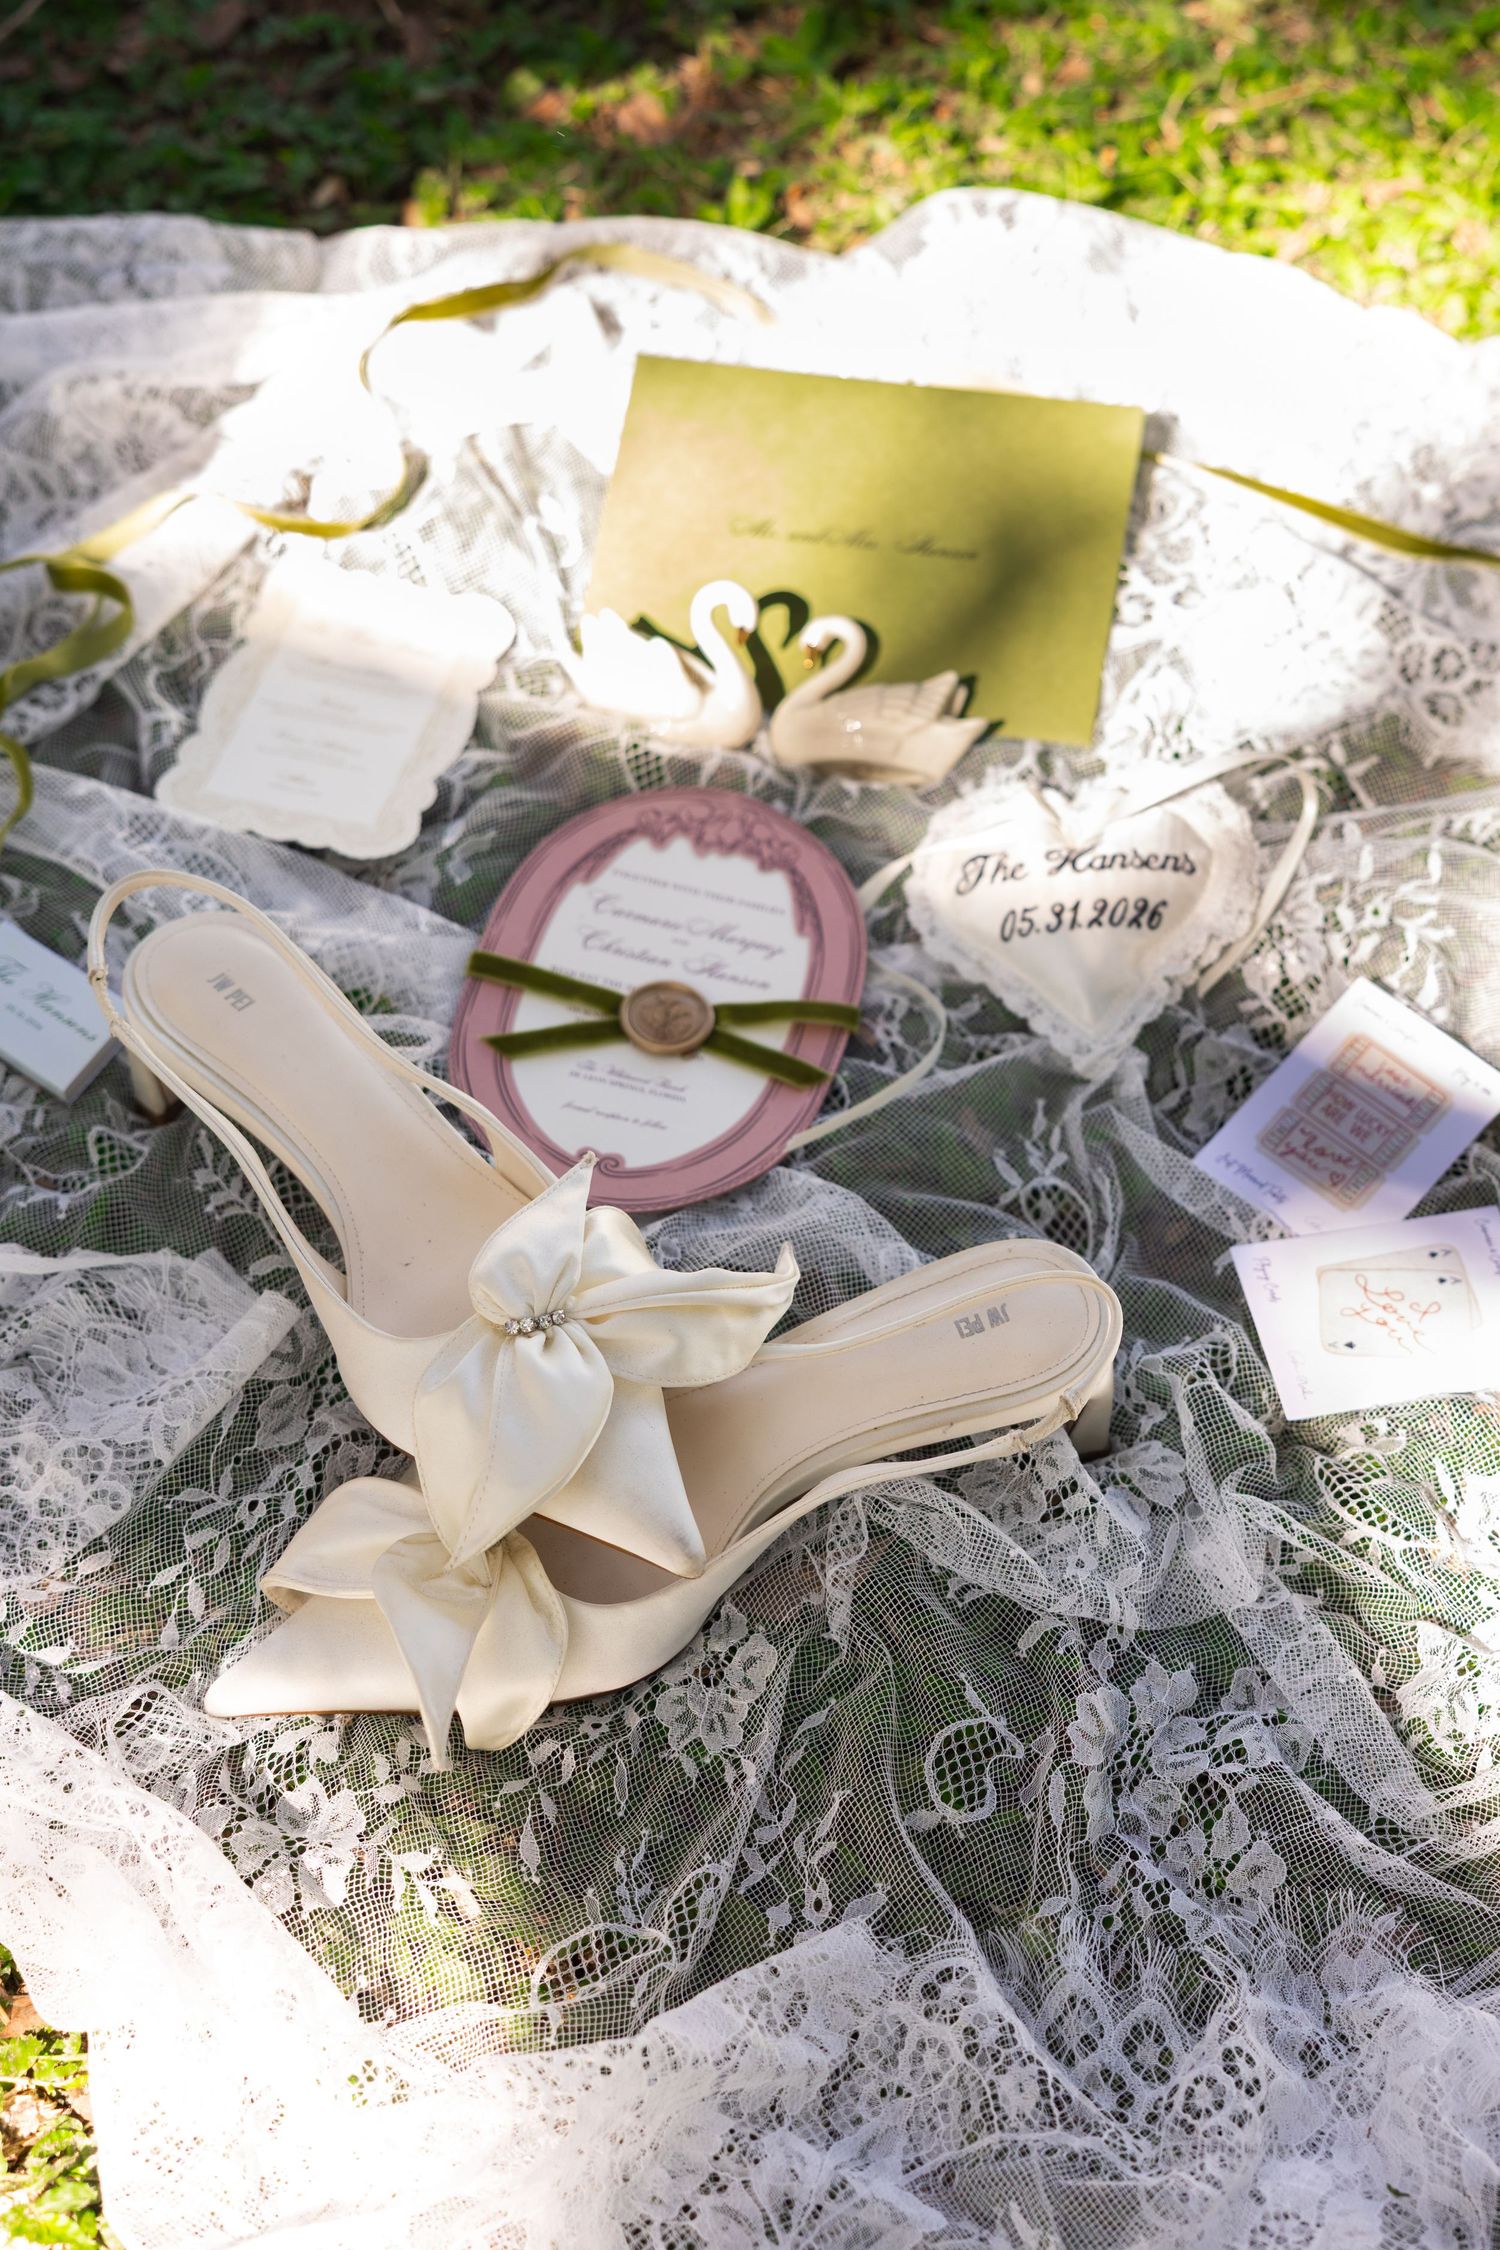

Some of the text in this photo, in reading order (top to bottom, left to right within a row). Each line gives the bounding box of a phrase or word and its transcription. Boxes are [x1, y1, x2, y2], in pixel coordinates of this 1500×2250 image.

[955, 843, 1197, 896] The Hansens
[1000, 897, 1168, 942] 05.31.2026
[206, 972, 256, 1011] JW PEI
[954, 1303, 1010, 1339] JW PEI
